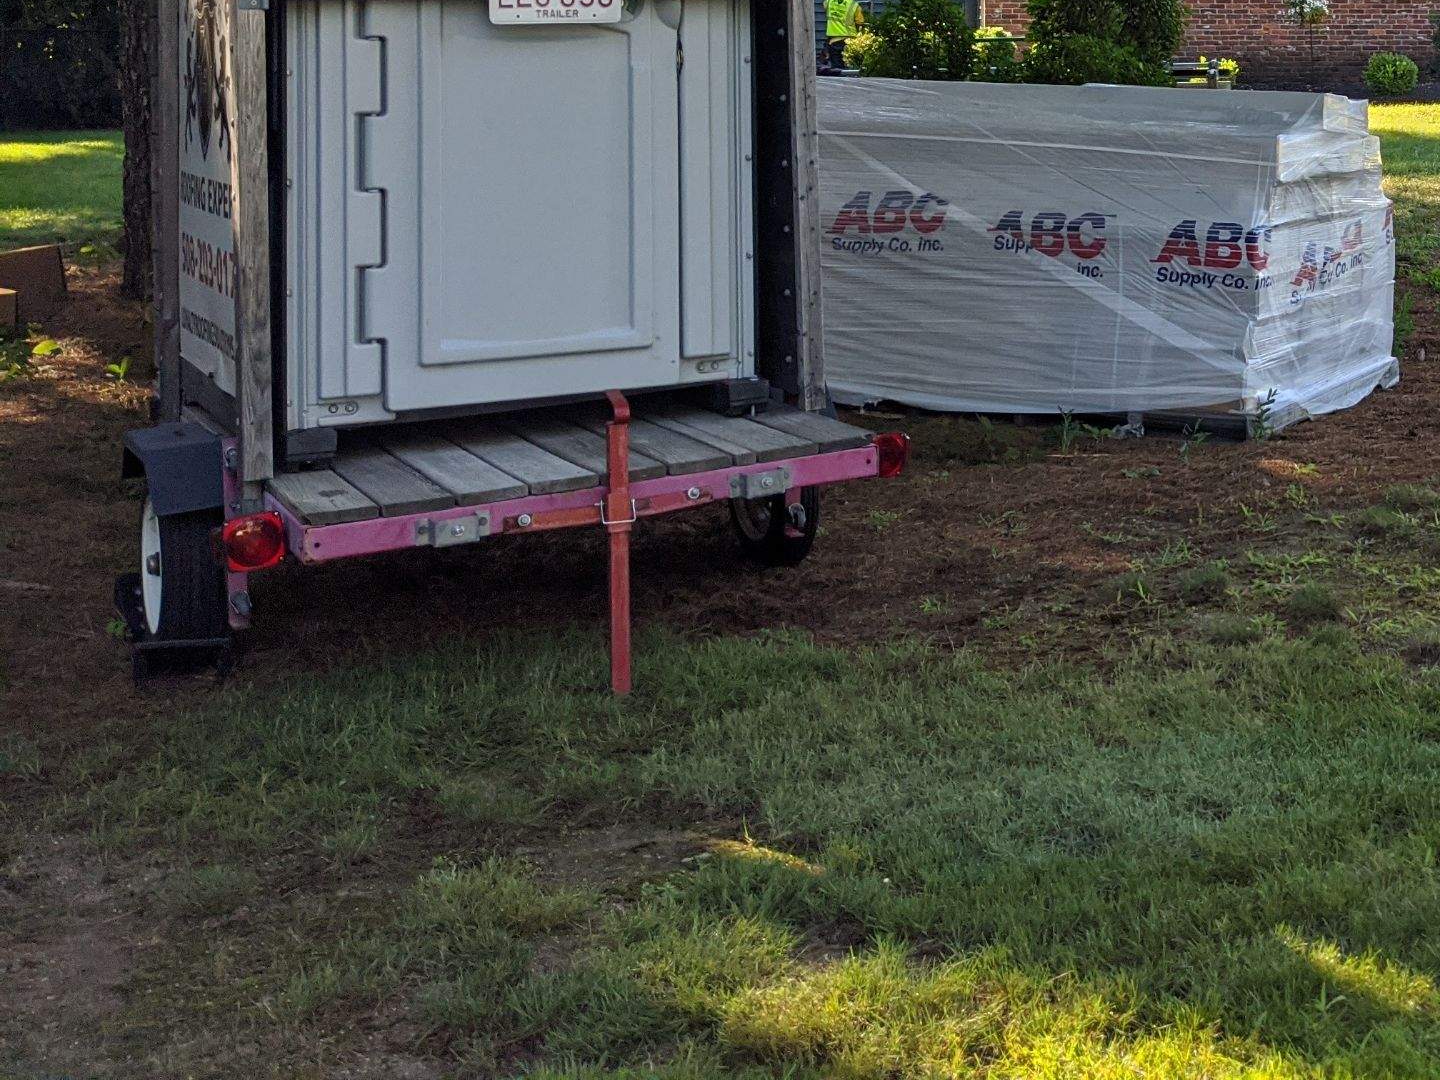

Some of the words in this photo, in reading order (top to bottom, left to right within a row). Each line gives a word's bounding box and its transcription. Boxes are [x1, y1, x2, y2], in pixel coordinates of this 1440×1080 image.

[536, 9, 579, 19] TRAILER
[825, 190, 950, 234] ABC
[832, 237, 884, 255] Supply
[887, 237, 912, 252] Co.
[986, 210, 1117, 259] ABC
[1149, 219, 1272, 271] ABC
[1077, 262, 1104, 278] inc.
[1156, 266, 1217, 289] Supply
[1221, 276, 1249, 290] Co.
